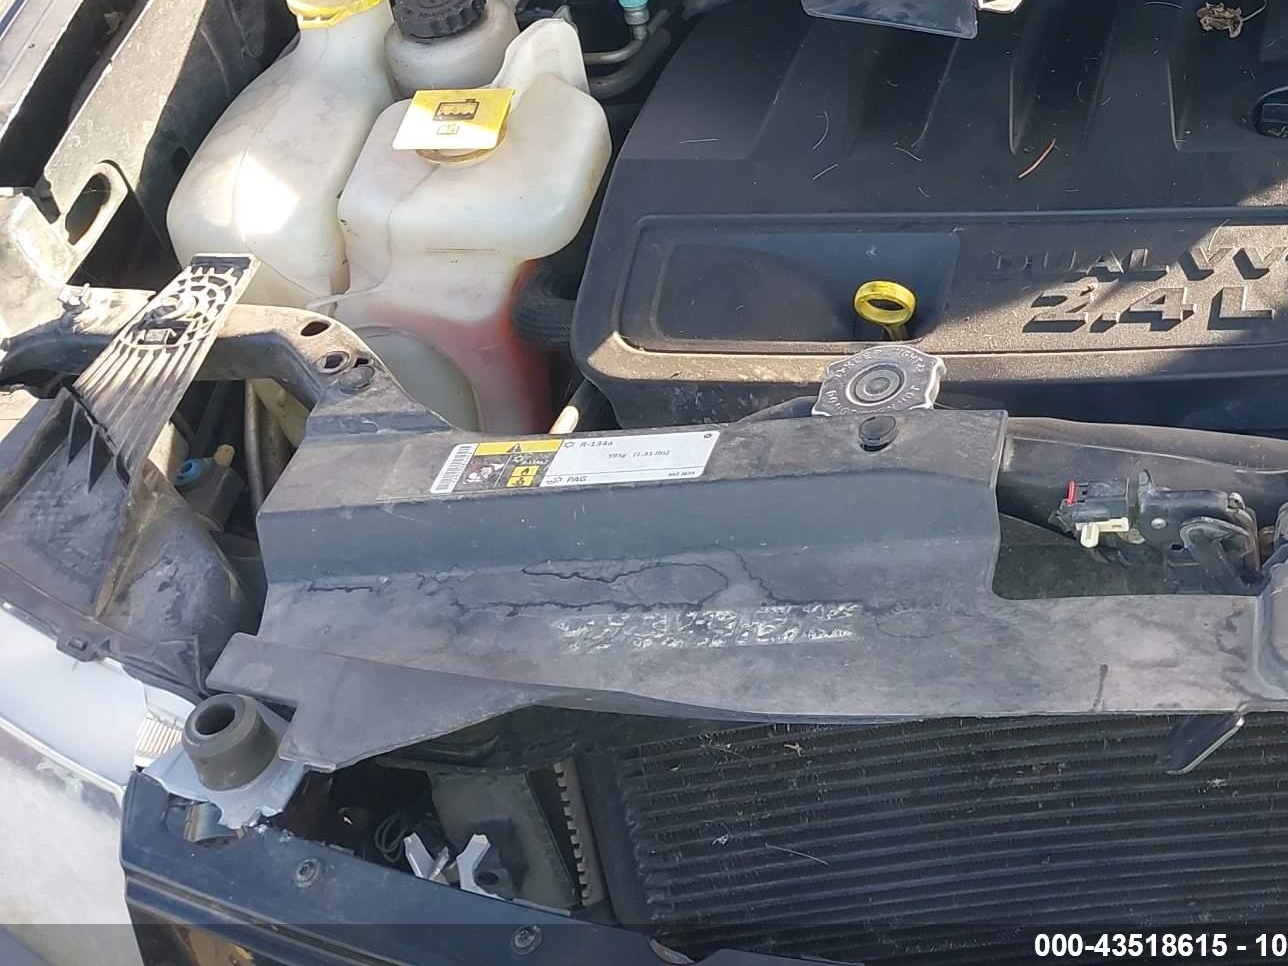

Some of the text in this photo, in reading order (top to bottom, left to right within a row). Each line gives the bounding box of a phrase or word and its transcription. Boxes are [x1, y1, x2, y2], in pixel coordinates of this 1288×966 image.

[991, 247, 1168, 281] DUAL
[1023, 285, 1273, 333] 2.4L
[580, 440, 614, 449] R-134a
[566, 475, 588, 483] PAG
